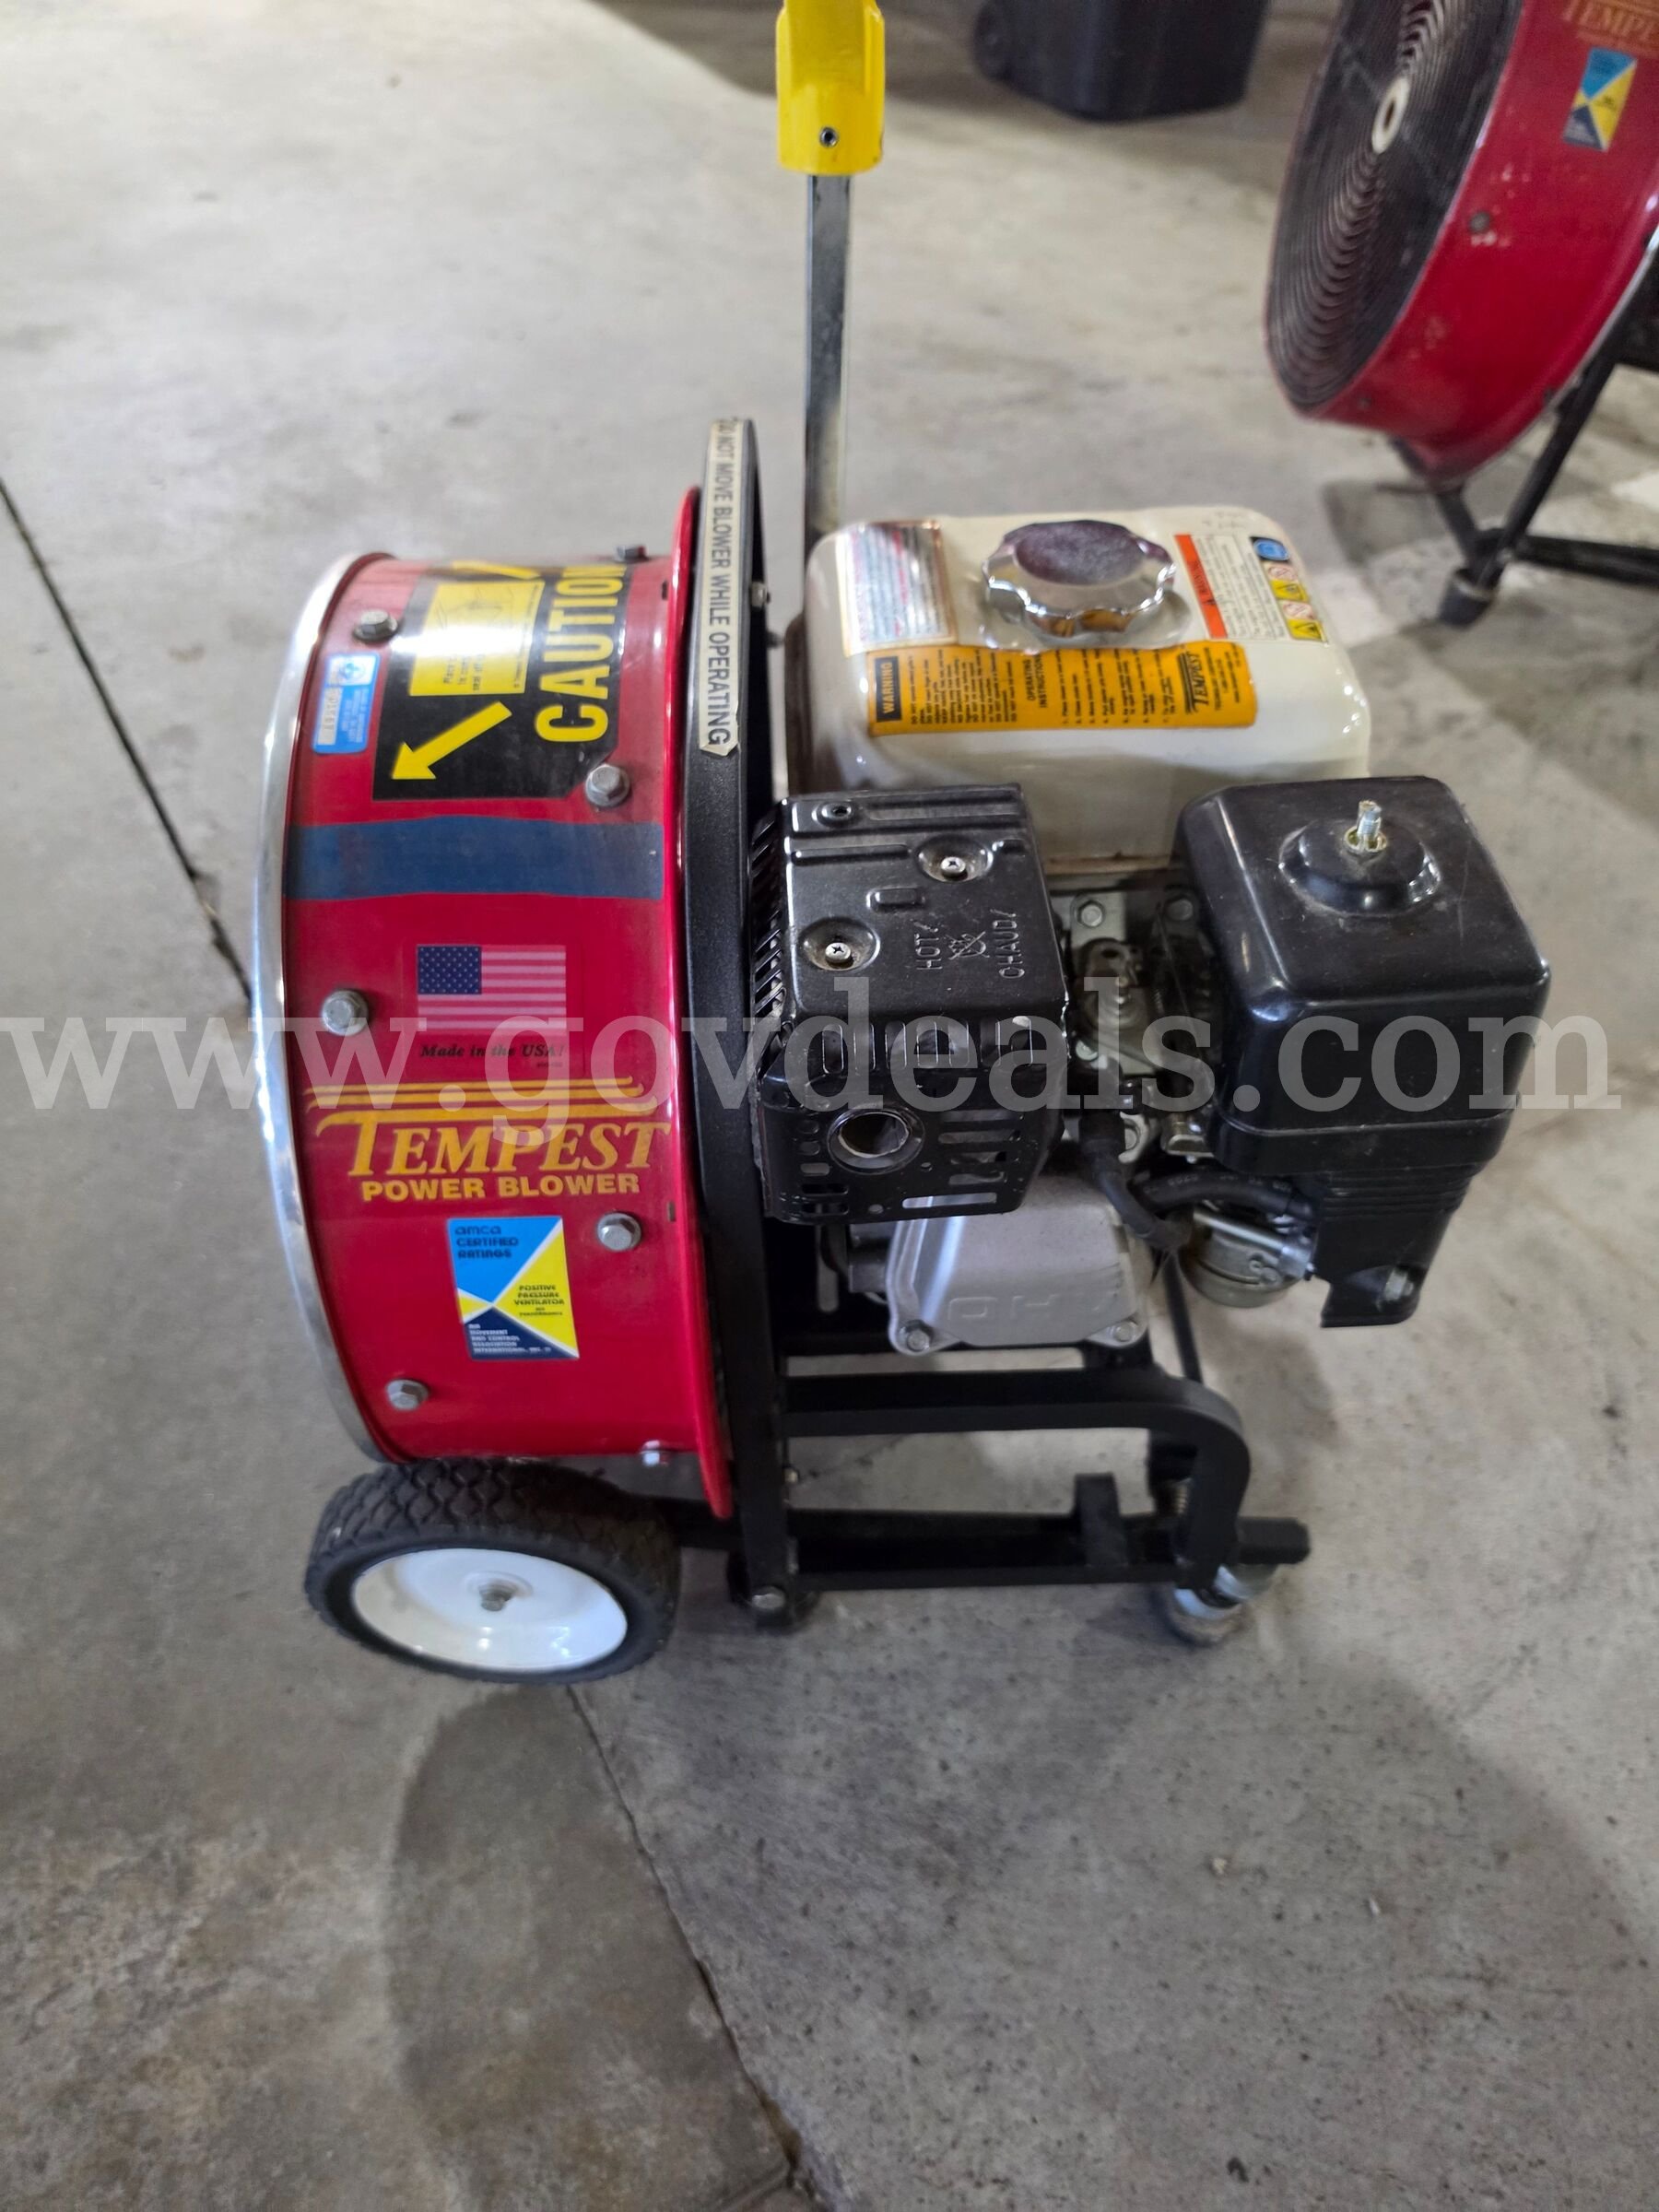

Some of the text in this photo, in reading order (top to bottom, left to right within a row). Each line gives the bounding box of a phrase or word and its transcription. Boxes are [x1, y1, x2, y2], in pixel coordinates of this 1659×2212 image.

[717, 437, 735, 459] NOT
[714, 464, 735, 501] MOVE
[711, 507, 733, 569] BLOWER
[709, 573, 731, 626] WHILE
[534, 562, 628, 744] CAUTION
[707, 631, 731, 745] OPERATING
[880, 662, 895, 713] WARNING
[1023, 660, 1035, 700] OPERATING
[420, 1044, 564, 1057] Made in the USA!
[316, 1099, 671, 1177] TEMPEST
[362, 1173, 641, 1202] POWER BLOWER
[455, 1226, 501, 1235] amca
[456, 1237, 519, 1247] CERTIFIED
